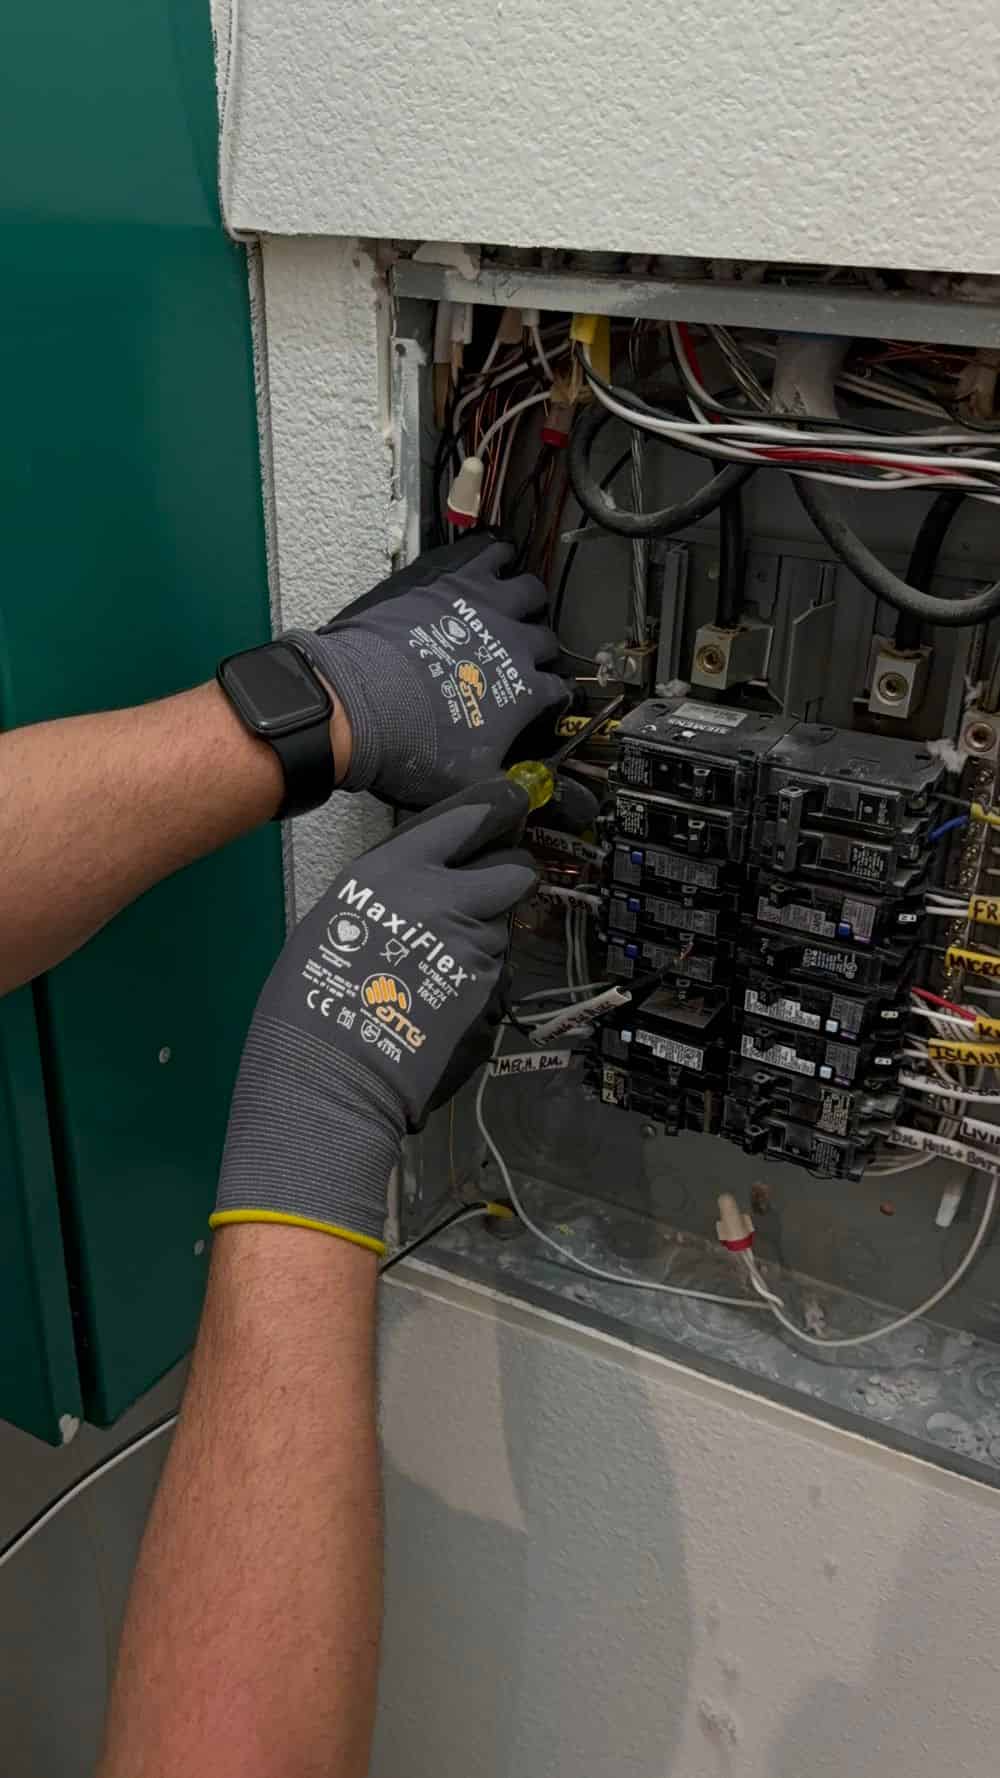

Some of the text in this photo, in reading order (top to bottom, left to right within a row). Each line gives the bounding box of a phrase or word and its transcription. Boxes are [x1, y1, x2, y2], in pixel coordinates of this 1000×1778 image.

[452, 598, 527, 695] MaxiFlex
[337, 879, 469, 987] MaxiFlex
[929, 1044, 1000, 1065] ISLAN
